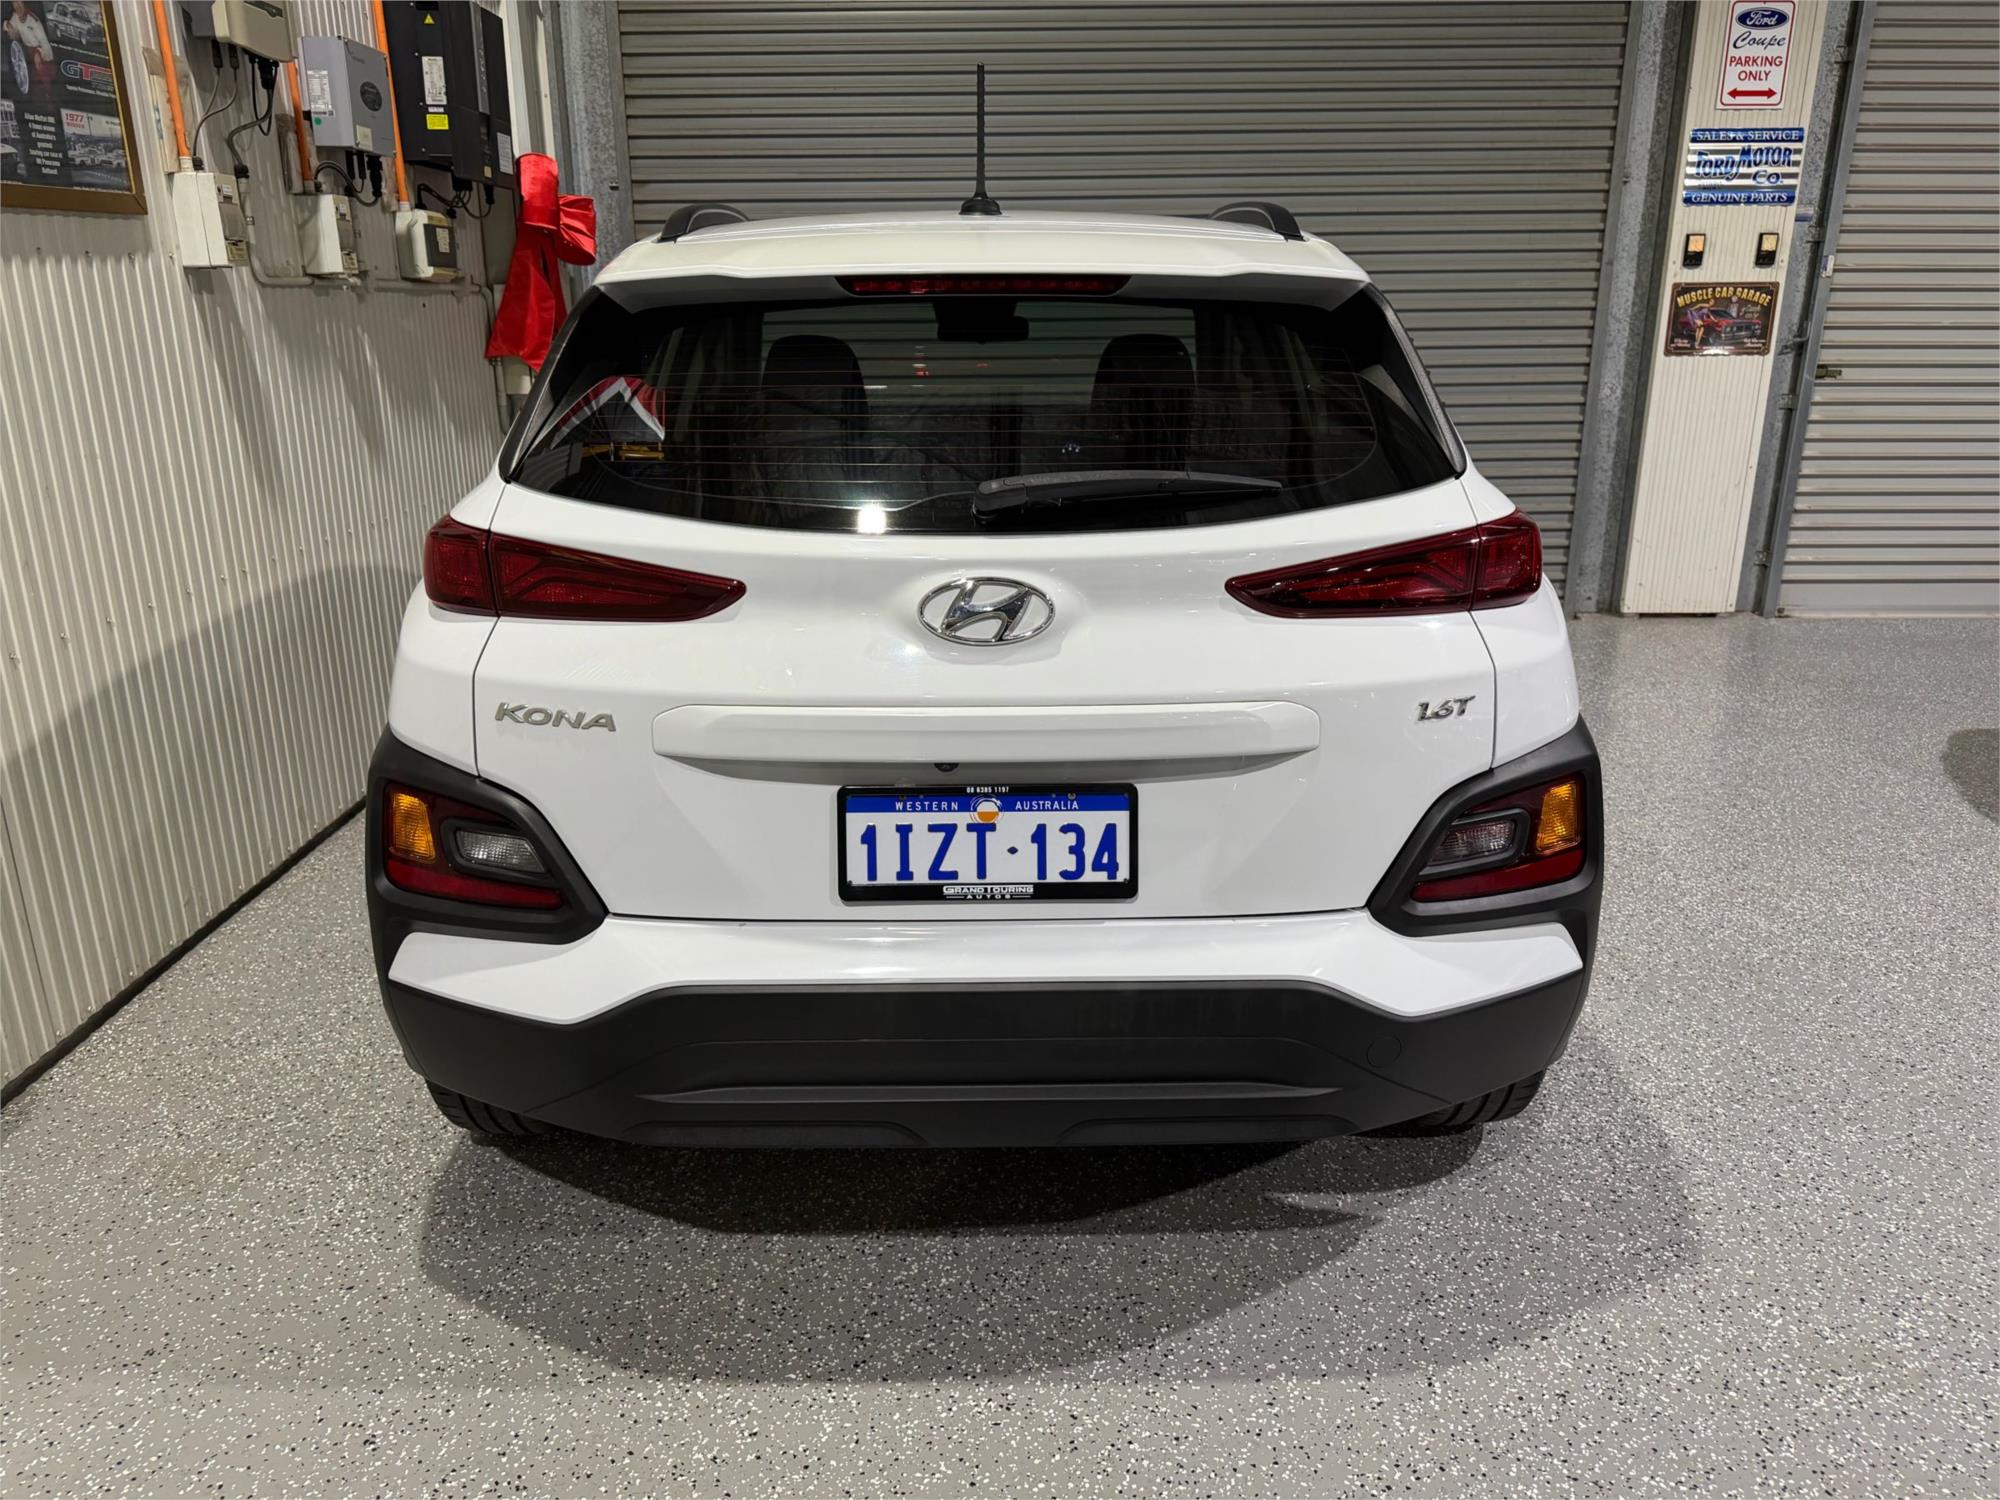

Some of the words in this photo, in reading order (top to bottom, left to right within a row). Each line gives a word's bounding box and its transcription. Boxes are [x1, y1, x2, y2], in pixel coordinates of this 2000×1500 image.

[1746, 10, 1779, 26] Ford
[1733, 30, 1786, 50] Coupe
[1729, 56, 1783, 67] PARKING
[1737, 70, 1771, 81] ONLY
[65, 112, 84, 122] 1977
[1696, 130, 1732, 141] SALES
[1747, 130, 1800, 140] SERVICE
[1740, 145, 1792, 169] MOTOR
[1691, 191, 1749, 203] GENUINE
[1750, 192, 1788, 202] PARTS
[1677, 288, 1713, 307] MUSCLE
[1736, 287, 1771, 306] GARAGE
[495, 702, 616, 732] KONA
[966, 786, 975, 794] 08
[976, 786, 992, 794] 6385
[895, 800, 959, 811] WESTERN
[1016, 800, 1079, 811] AUSTRALIA
[943, 885, 984, 895] GRAND
[985, 885, 1034, 894] TOURING
